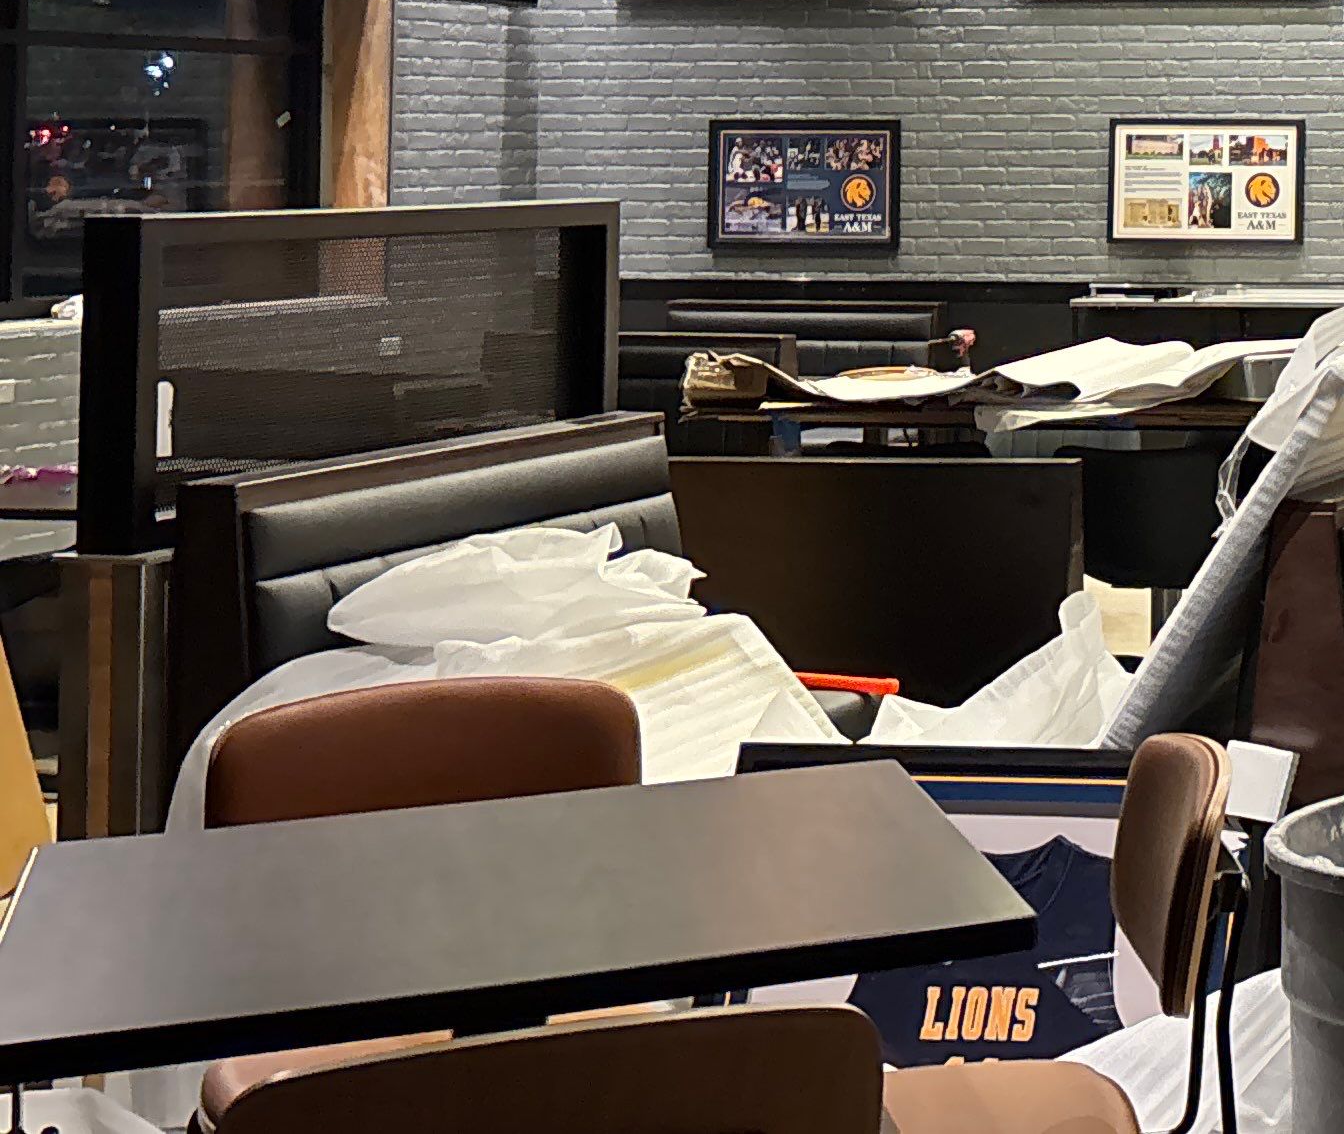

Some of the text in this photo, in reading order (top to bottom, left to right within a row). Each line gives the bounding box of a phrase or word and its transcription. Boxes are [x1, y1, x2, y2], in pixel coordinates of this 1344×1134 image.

[1238, 211, 1258, 219] EAST
[843, 222, 872, 232] A&M
[1247, 220, 1276, 230] A&M
[919, 986, 1039, 1042] LIONS
